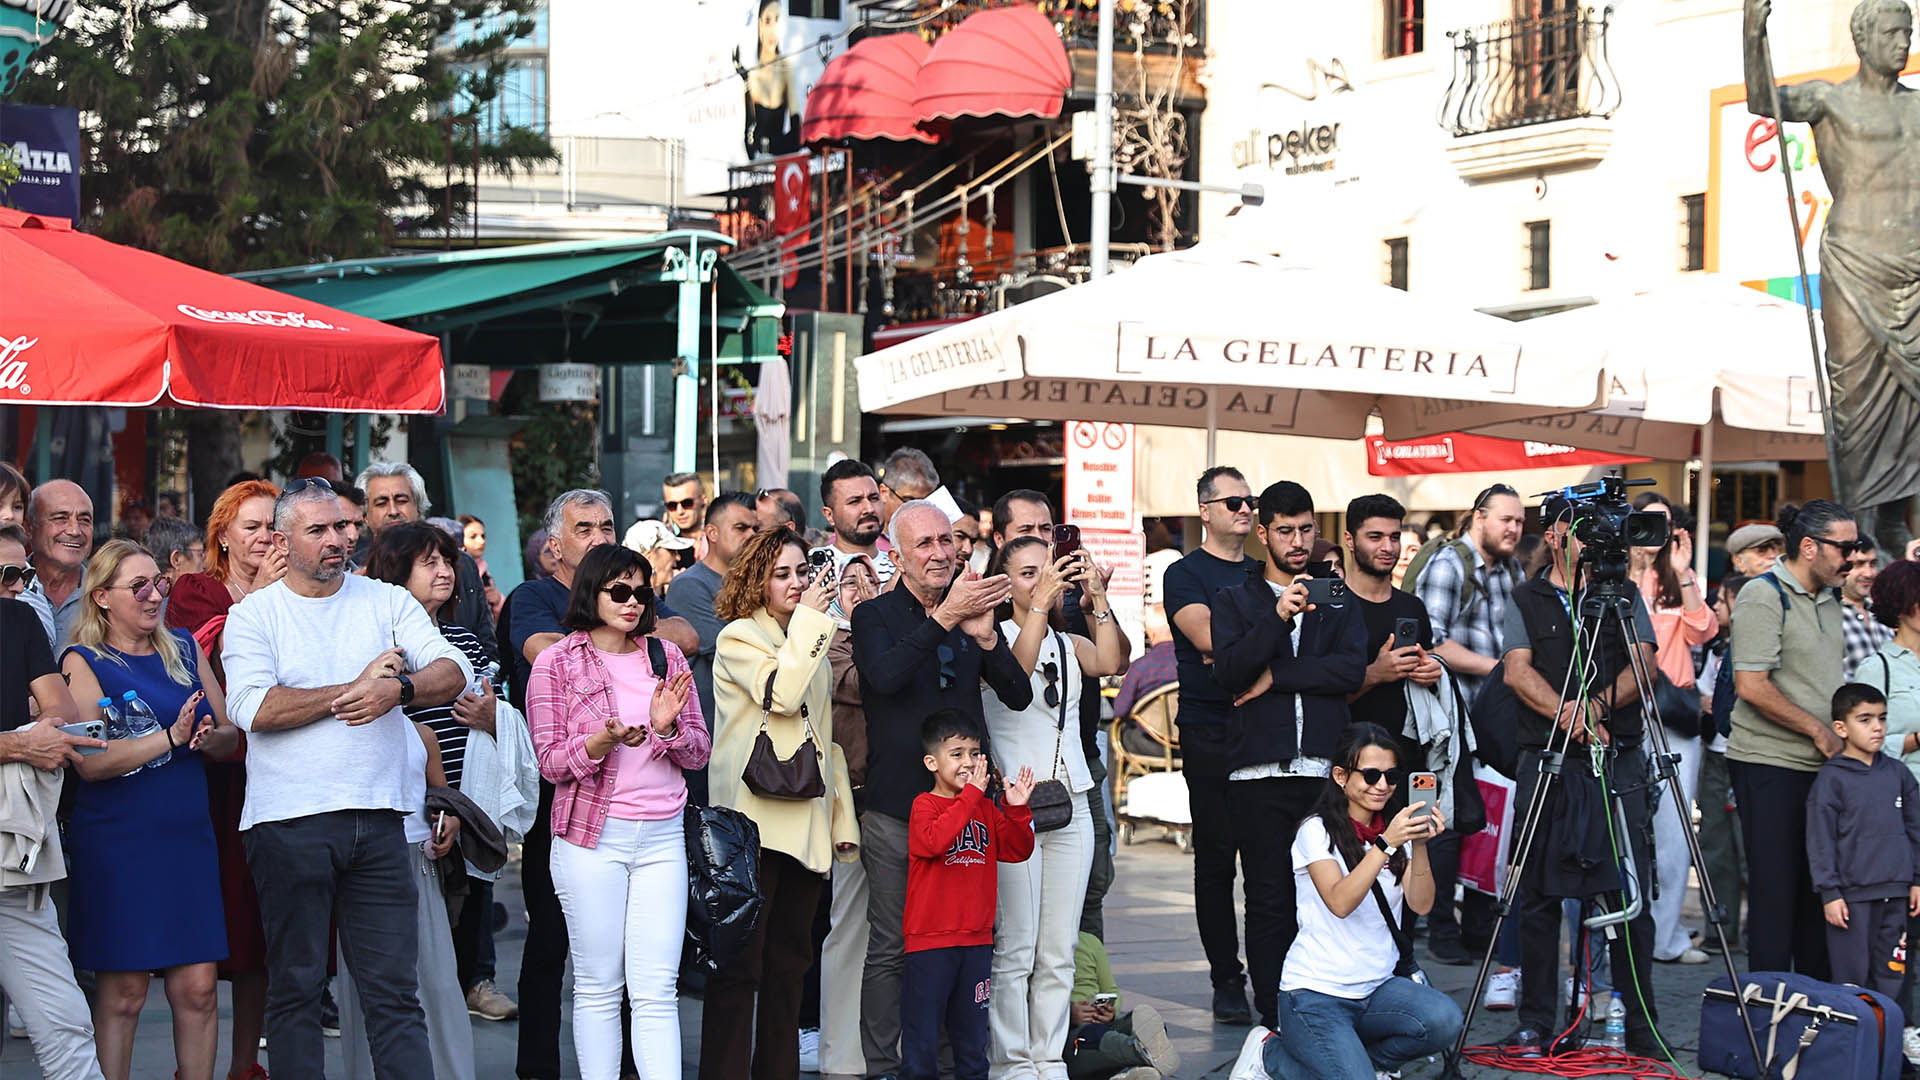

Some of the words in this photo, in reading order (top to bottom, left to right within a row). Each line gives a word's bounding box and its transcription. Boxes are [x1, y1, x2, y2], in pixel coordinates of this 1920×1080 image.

[1267, 120, 1341, 169] peker
[177, 304, 334, 330] Coca-Cola
[889, 359, 908, 384] LA
[910, 338, 993, 377] GELATERIA
[1145, 336, 1199, 361] LA
[1223, 339, 1489, 378] GELATERIA
[1481, 822, 1499, 837] AN
